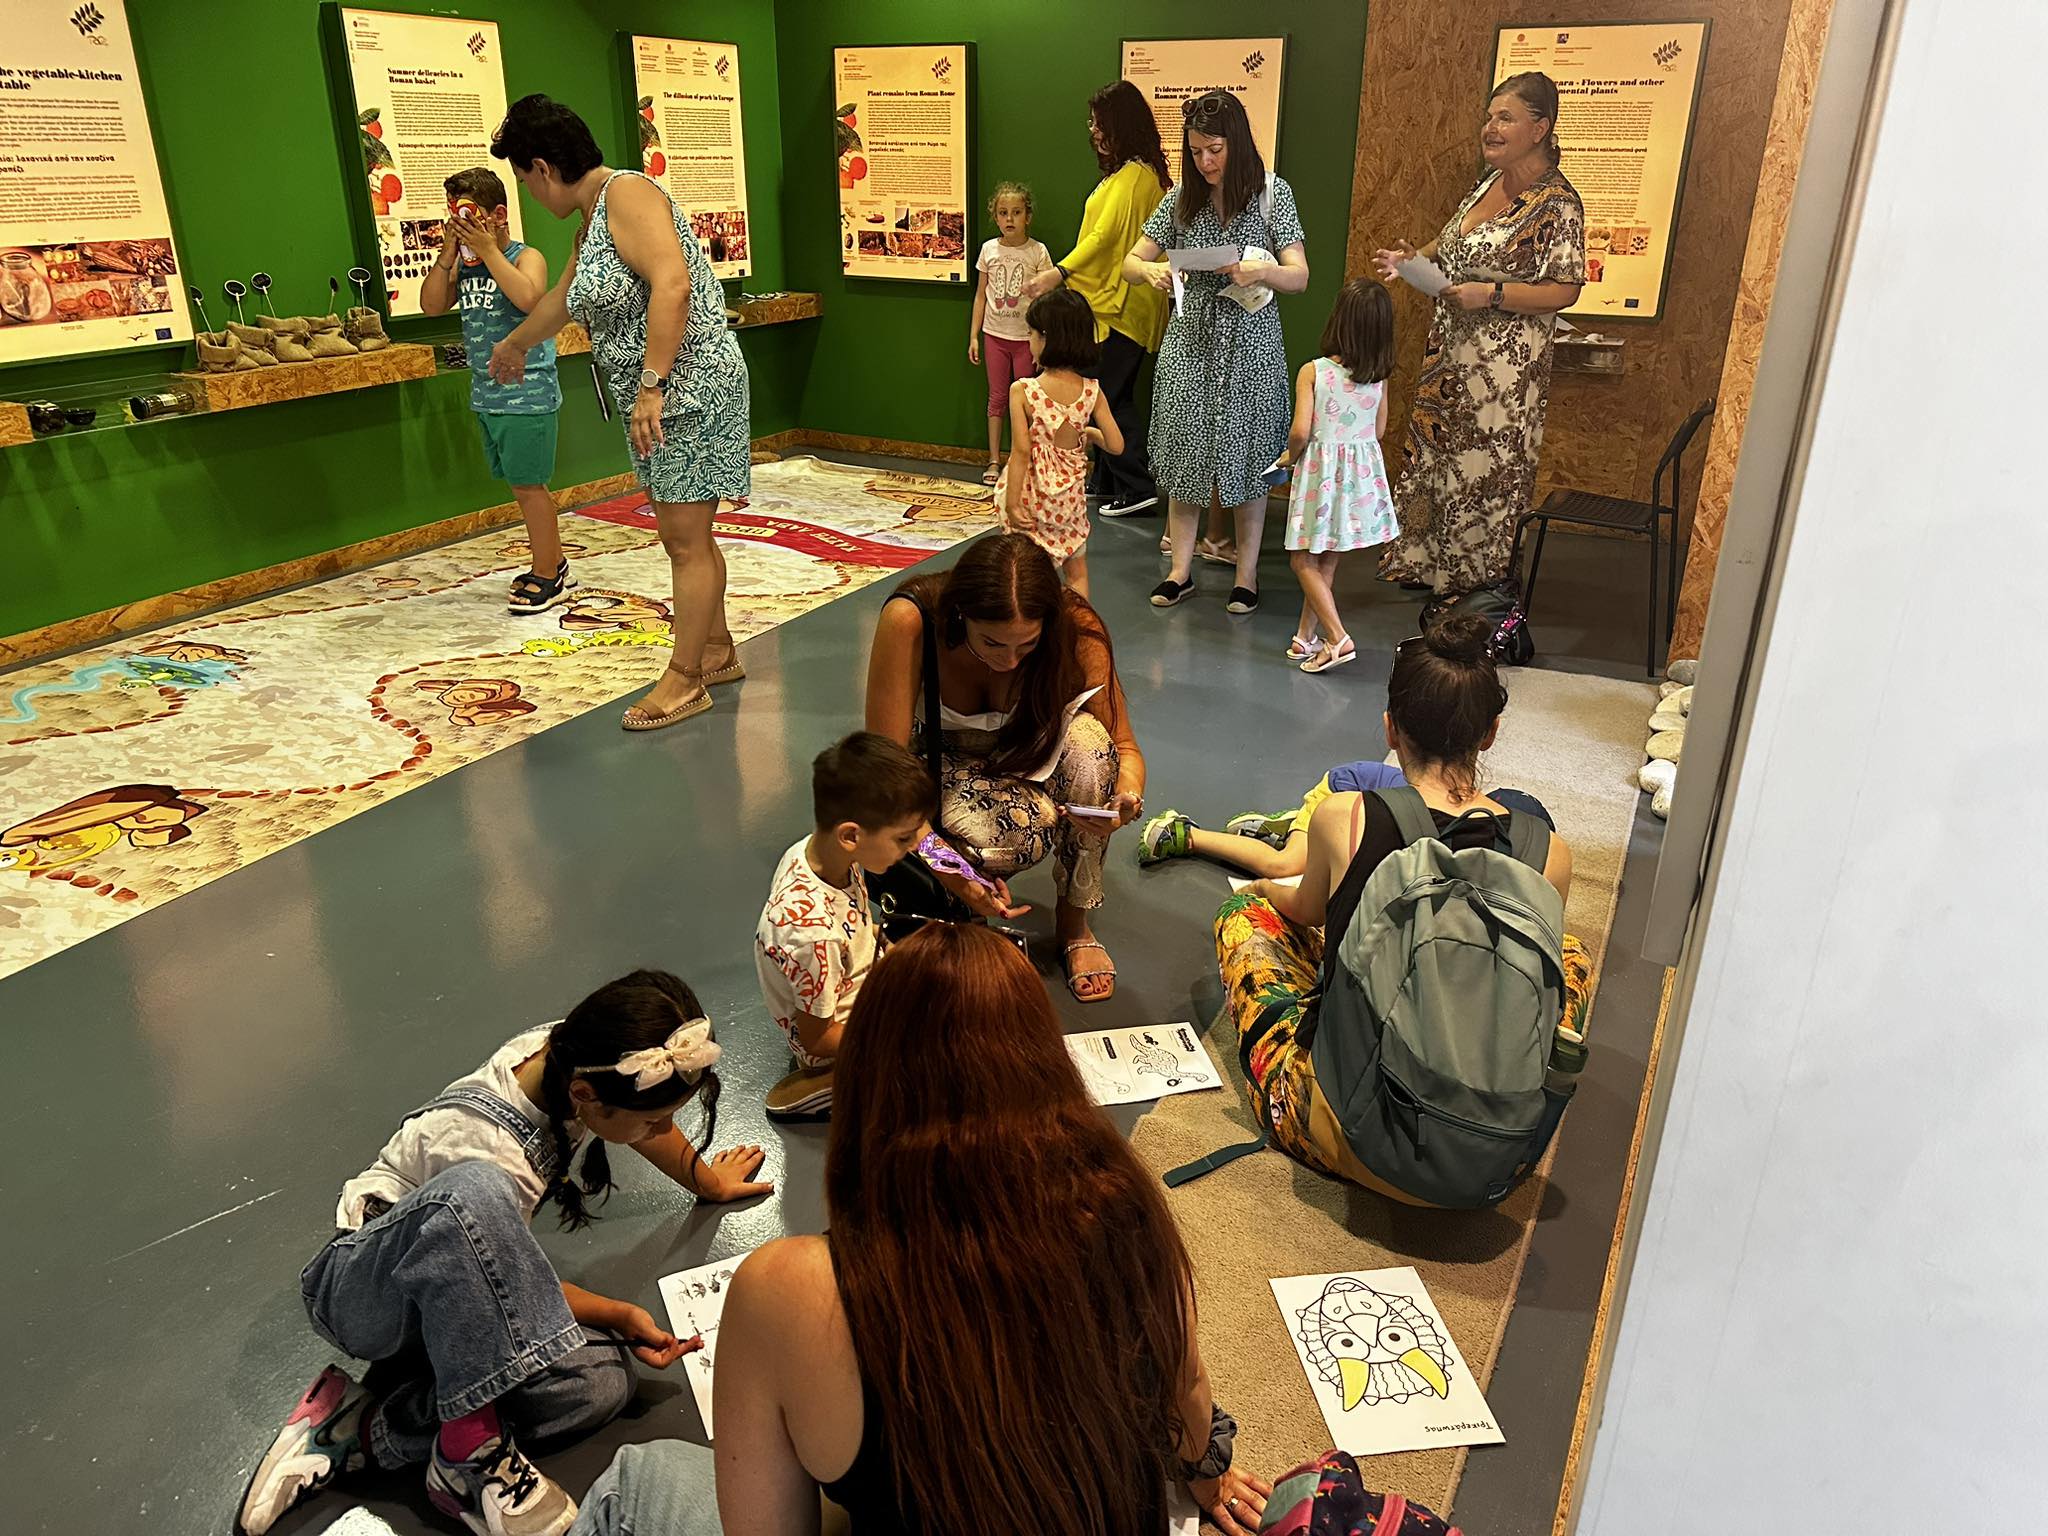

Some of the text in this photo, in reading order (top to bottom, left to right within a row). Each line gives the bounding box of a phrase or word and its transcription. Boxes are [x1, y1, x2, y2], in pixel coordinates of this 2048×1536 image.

[0, 67, 123, 81] he vegetable-kitchen
[387, 67, 416, 76] Summer
[450, 70, 458, 78] in
[389, 76, 436, 85] Roman basket
[1638, 78, 1665, 86] other
[1557, 87, 1618, 96] mental plants
[0, 165, 24, 175] ραπέζι
[460, 277, 498, 294] WILD
[461, 293, 494, 310] LIFE
[711, 523, 768, 536] ΠΡΟΣ
